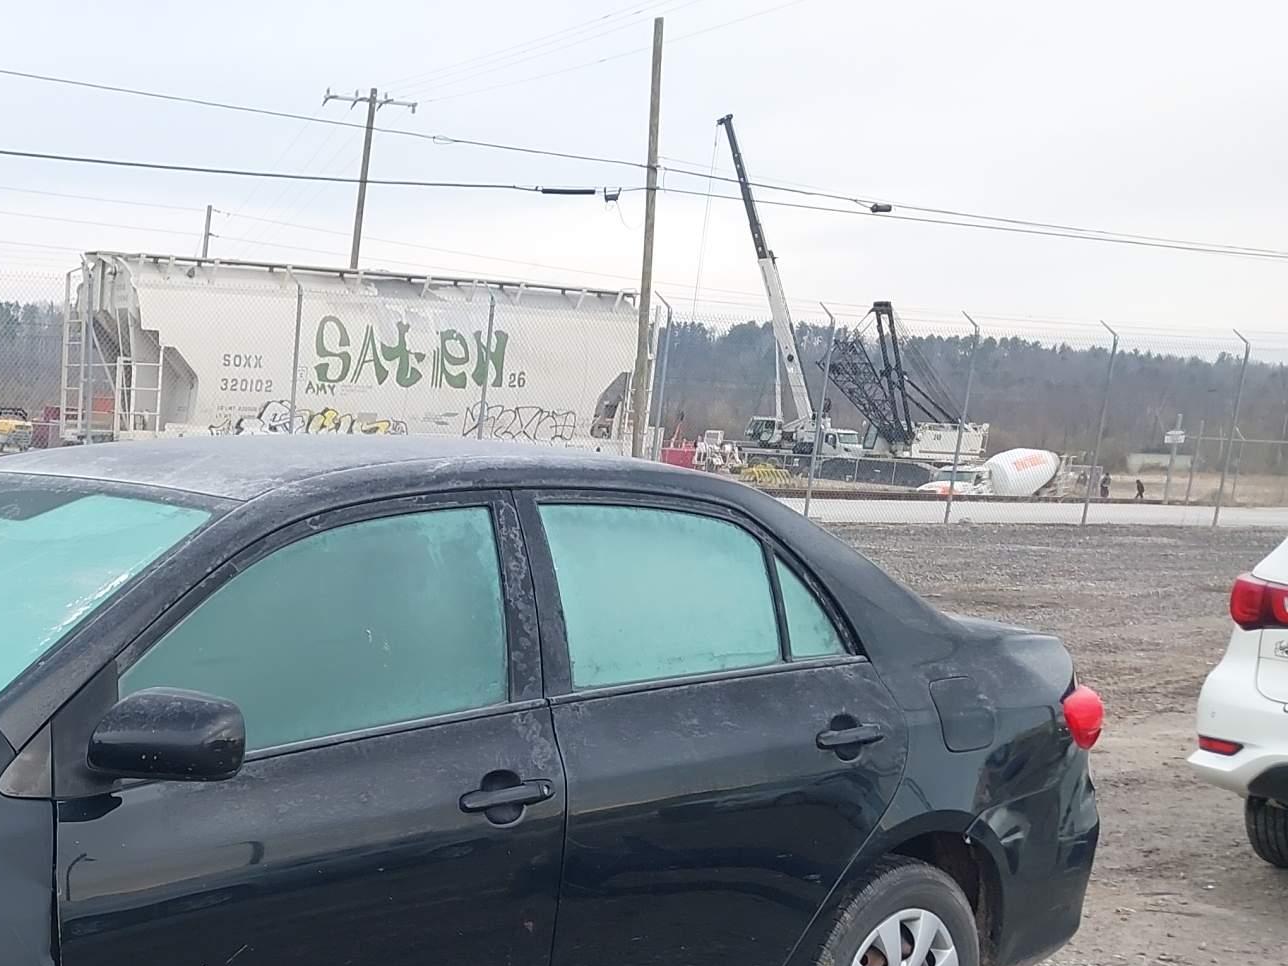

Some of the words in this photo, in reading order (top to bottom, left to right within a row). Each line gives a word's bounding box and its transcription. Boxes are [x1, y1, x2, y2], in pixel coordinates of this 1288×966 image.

[222, 353, 263, 369] SOXX
[220, 377, 273, 393] 320102
[507, 371, 527, 389] 26
[305, 380, 336, 397] AMY
